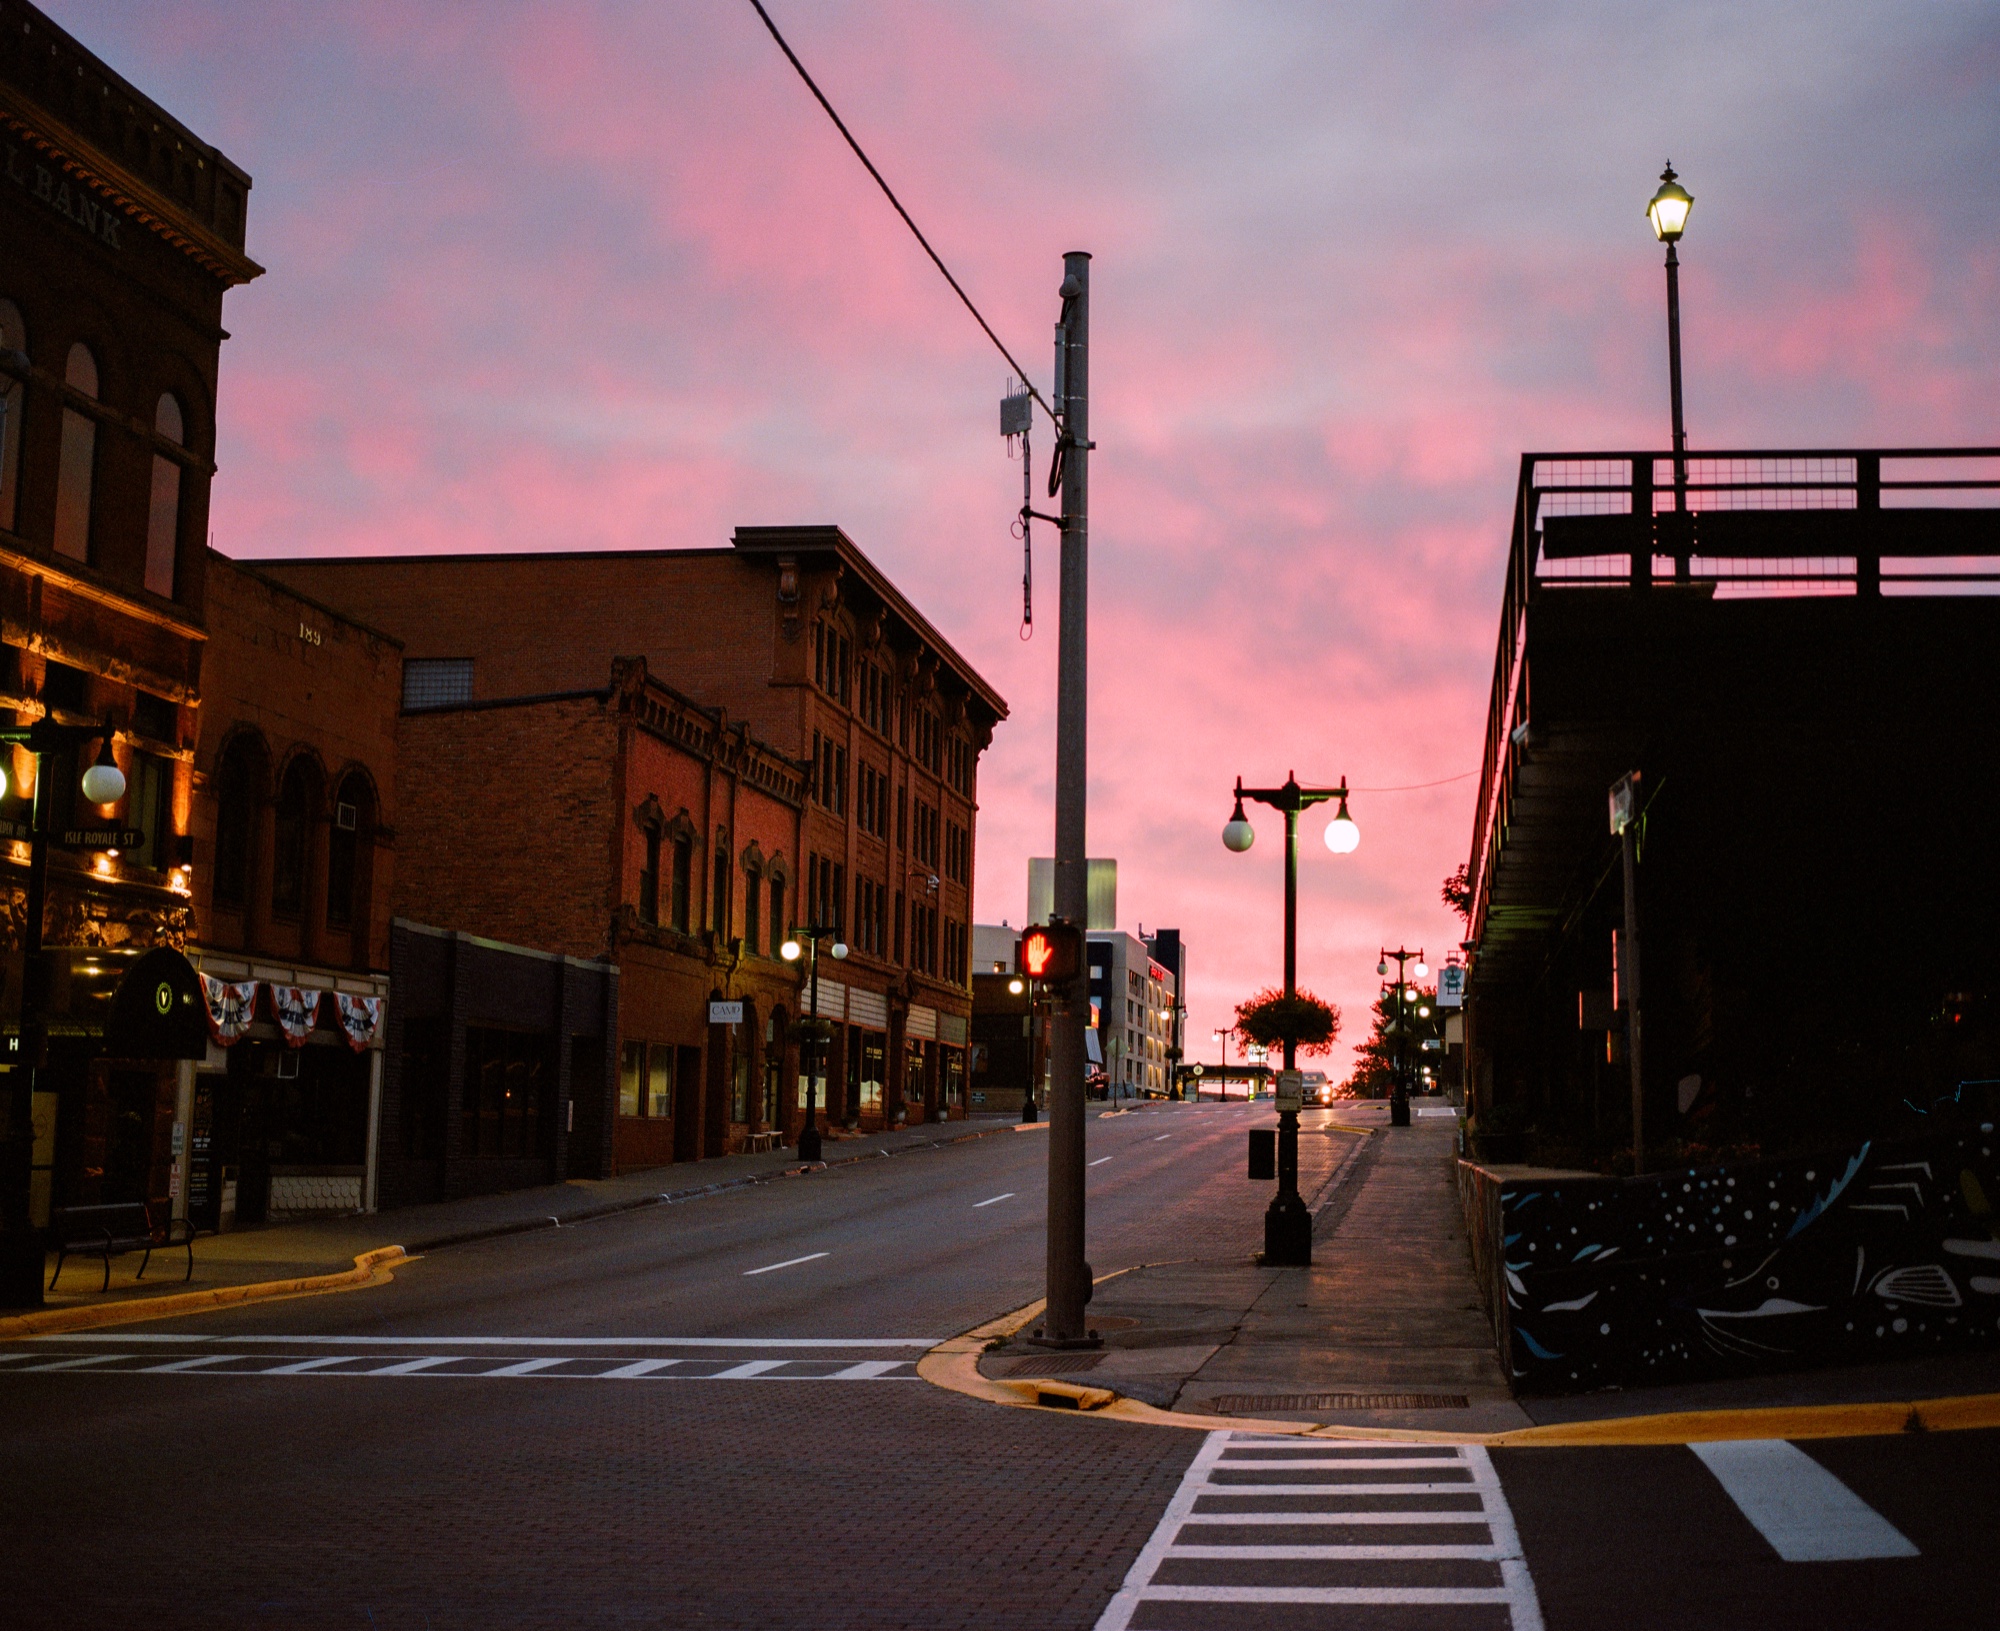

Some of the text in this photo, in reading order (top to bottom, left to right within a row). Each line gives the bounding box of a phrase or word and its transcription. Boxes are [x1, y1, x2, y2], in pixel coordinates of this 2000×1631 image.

[31, 163, 121, 250] BANK
[64, 830, 136, 847] ISLE ROYALE ST
[712, 1005, 741, 1016] CAMP
